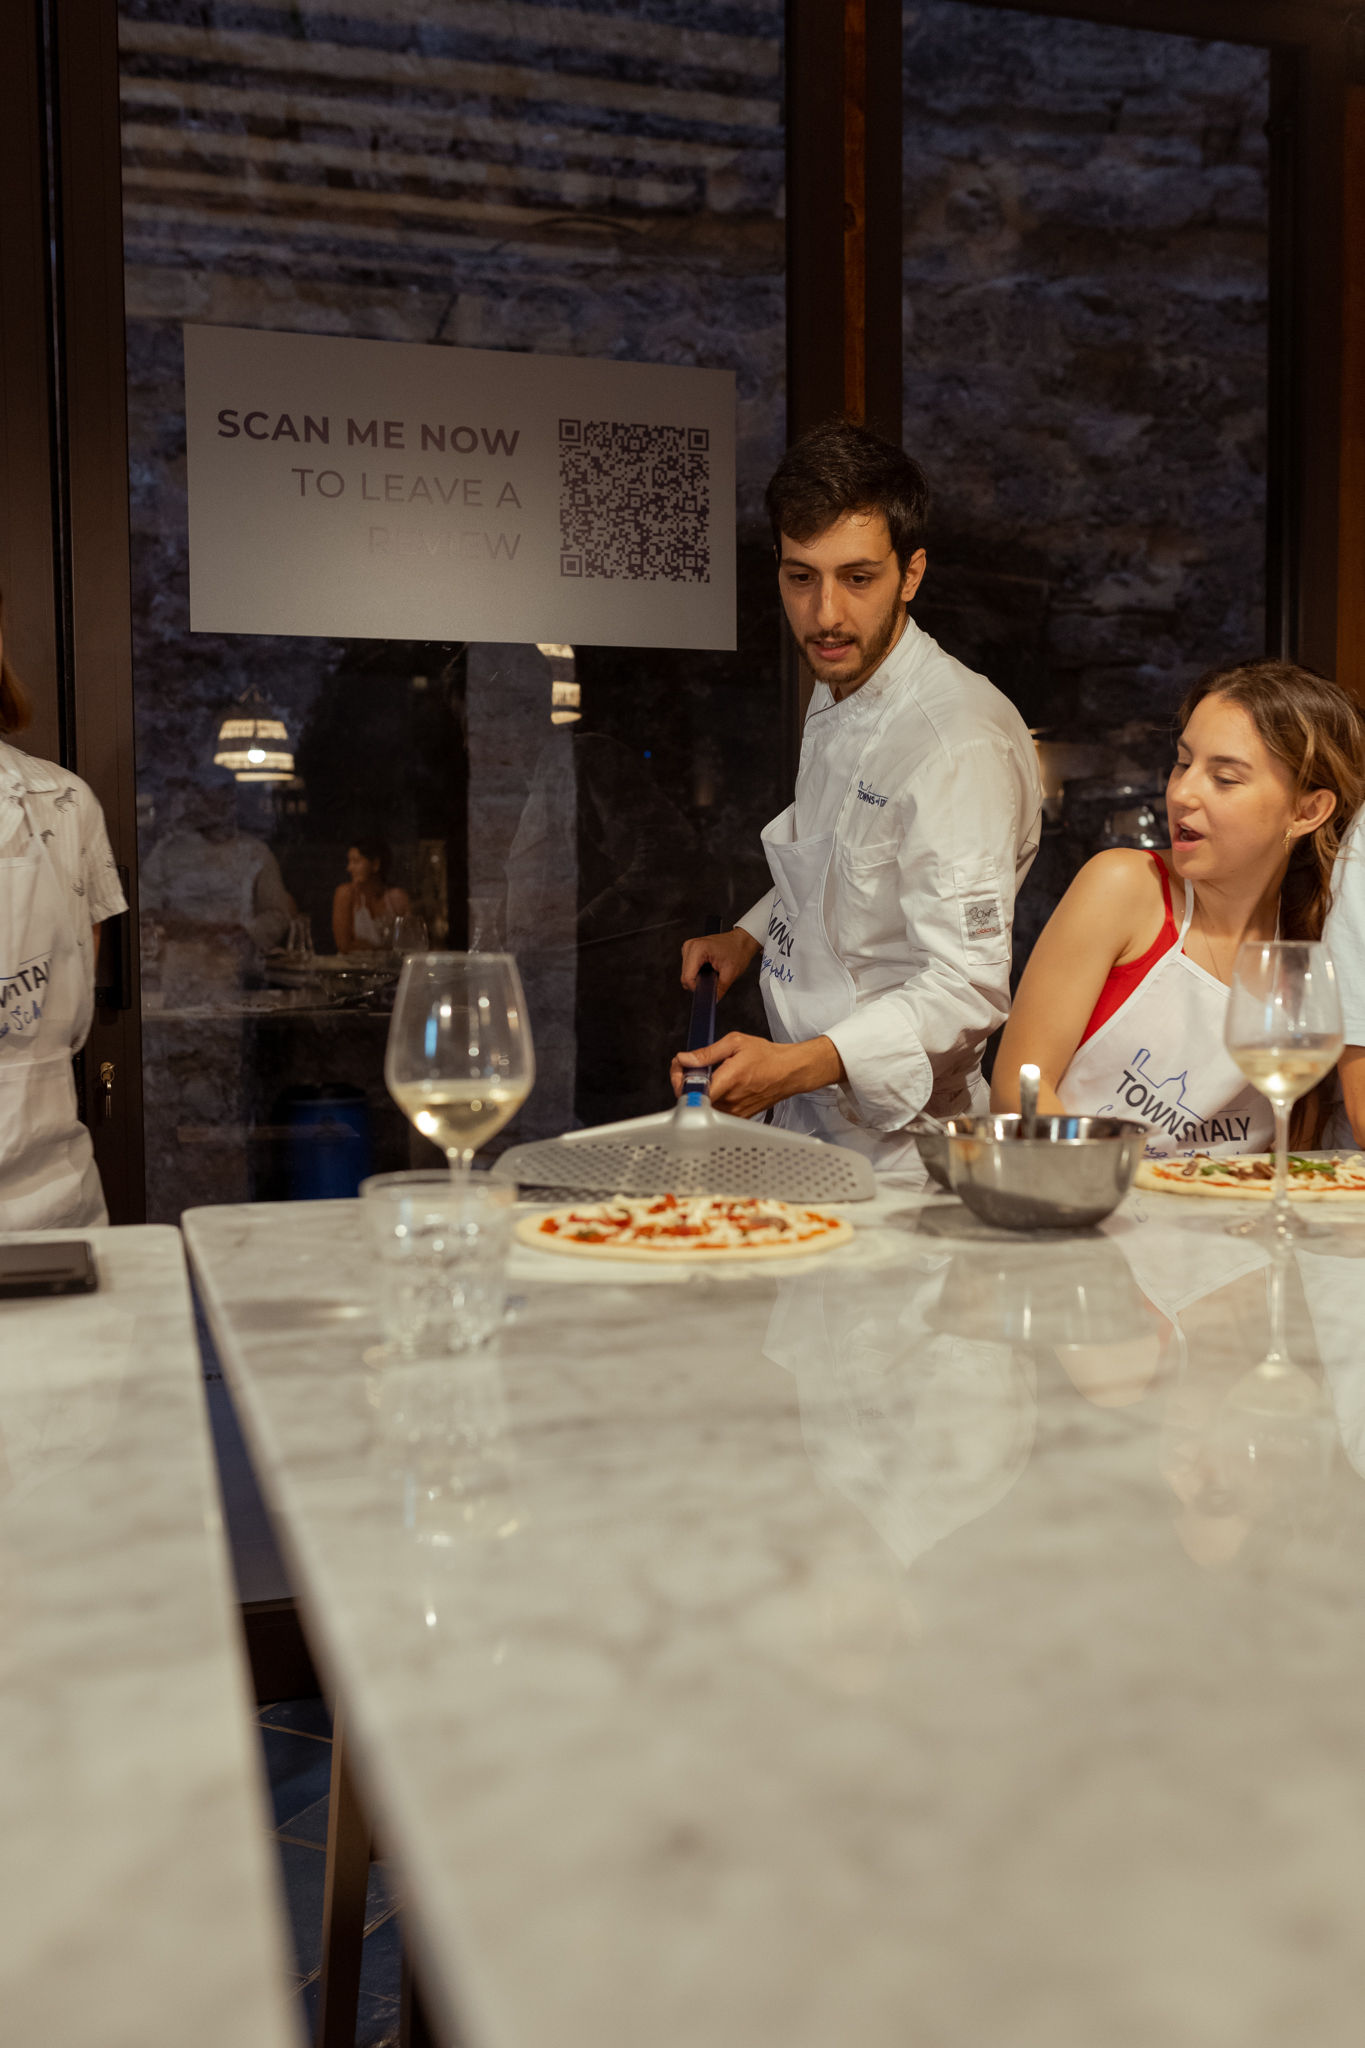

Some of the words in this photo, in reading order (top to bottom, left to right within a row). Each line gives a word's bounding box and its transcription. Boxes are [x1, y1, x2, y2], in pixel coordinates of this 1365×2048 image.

[216, 408, 330, 445] SCAN
[346, 417, 406, 449] ME
[420, 423, 521, 457] NOW
[291, 467, 346, 499] TO
[361, 472, 484, 508] LEAVE
[495, 481, 523, 510] A
